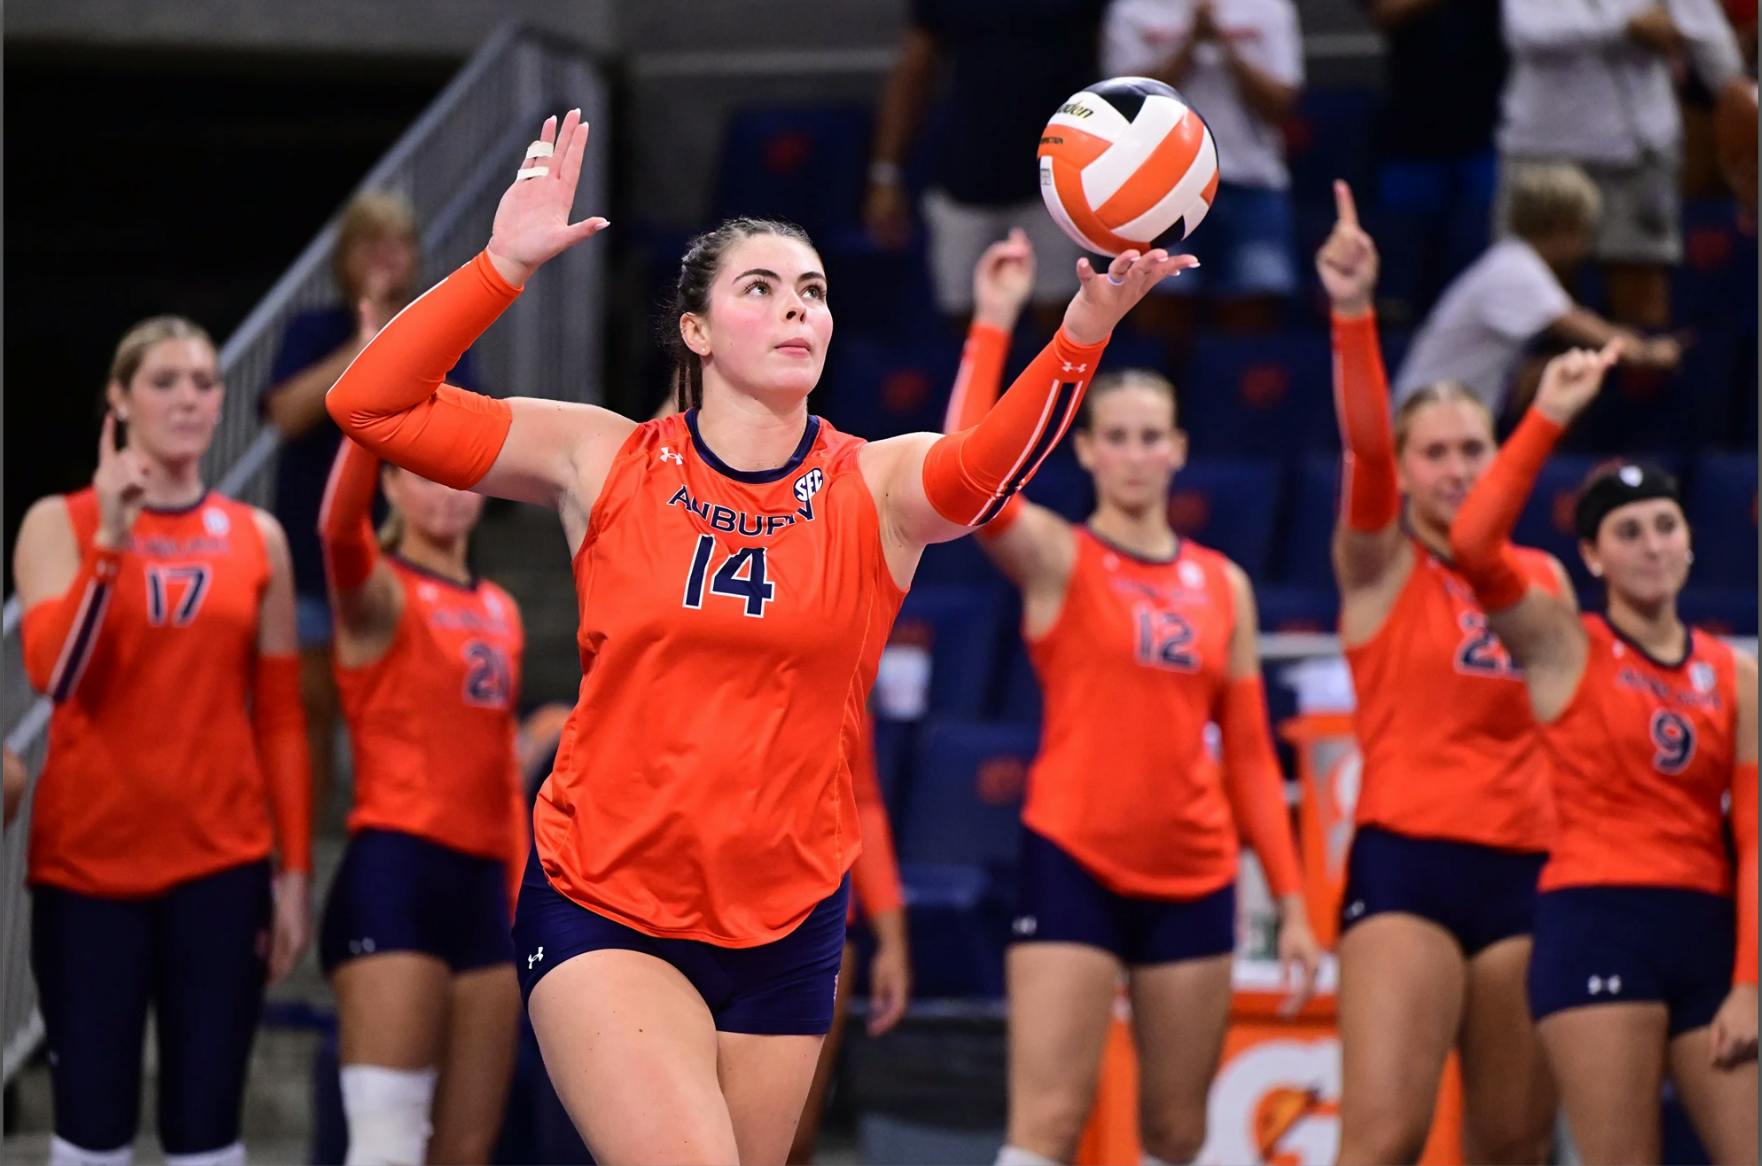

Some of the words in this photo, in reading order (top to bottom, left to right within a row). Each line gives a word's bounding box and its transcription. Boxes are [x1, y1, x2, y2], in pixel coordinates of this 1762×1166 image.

[793, 468, 823, 502] SEC
[146, 564, 212, 626] 17
[682, 533, 775, 618] 14
[1135, 604, 1200, 671] 12
[1454, 611, 1526, 681] 2
[1651, 709, 1696, 775] 9
